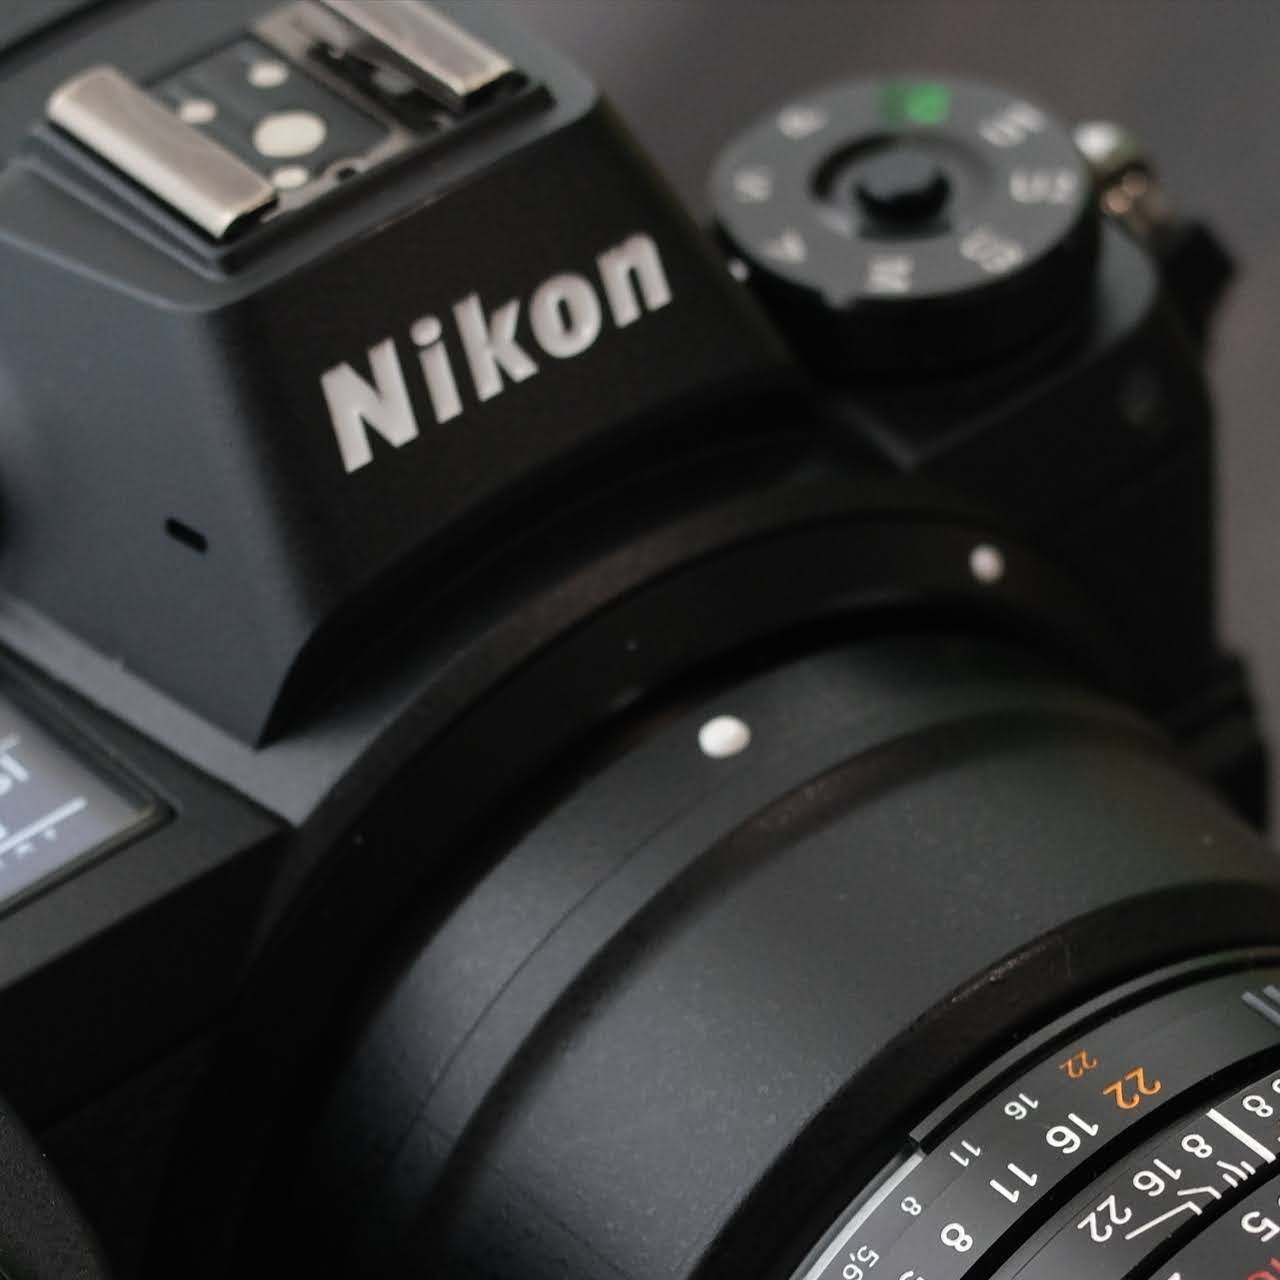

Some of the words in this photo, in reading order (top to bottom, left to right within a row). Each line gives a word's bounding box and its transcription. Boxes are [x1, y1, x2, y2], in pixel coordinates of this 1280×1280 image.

[320, 232, 673, 474] Nikon
[1059, 1051, 1097, 1078] 22
[1103, 1067, 1162, 1109] 22
[1004, 1093, 1039, 1120] 16
[1242, 1095, 1274, 1118] 8
[1045, 1112, 1099, 1154] 16
[1181, 1134, 1213, 1159] 8
[949, 1140, 981, 1167] 11
[989, 1162, 1038, 1203] 11
[1132, 1158, 1182, 1197] 16
[900, 1196, 922, 1216] 8
[1077, 1194, 1132, 1242] 22
[940, 1222, 973, 1253] 8
[1241, 1211, 1280, 1242] 5
